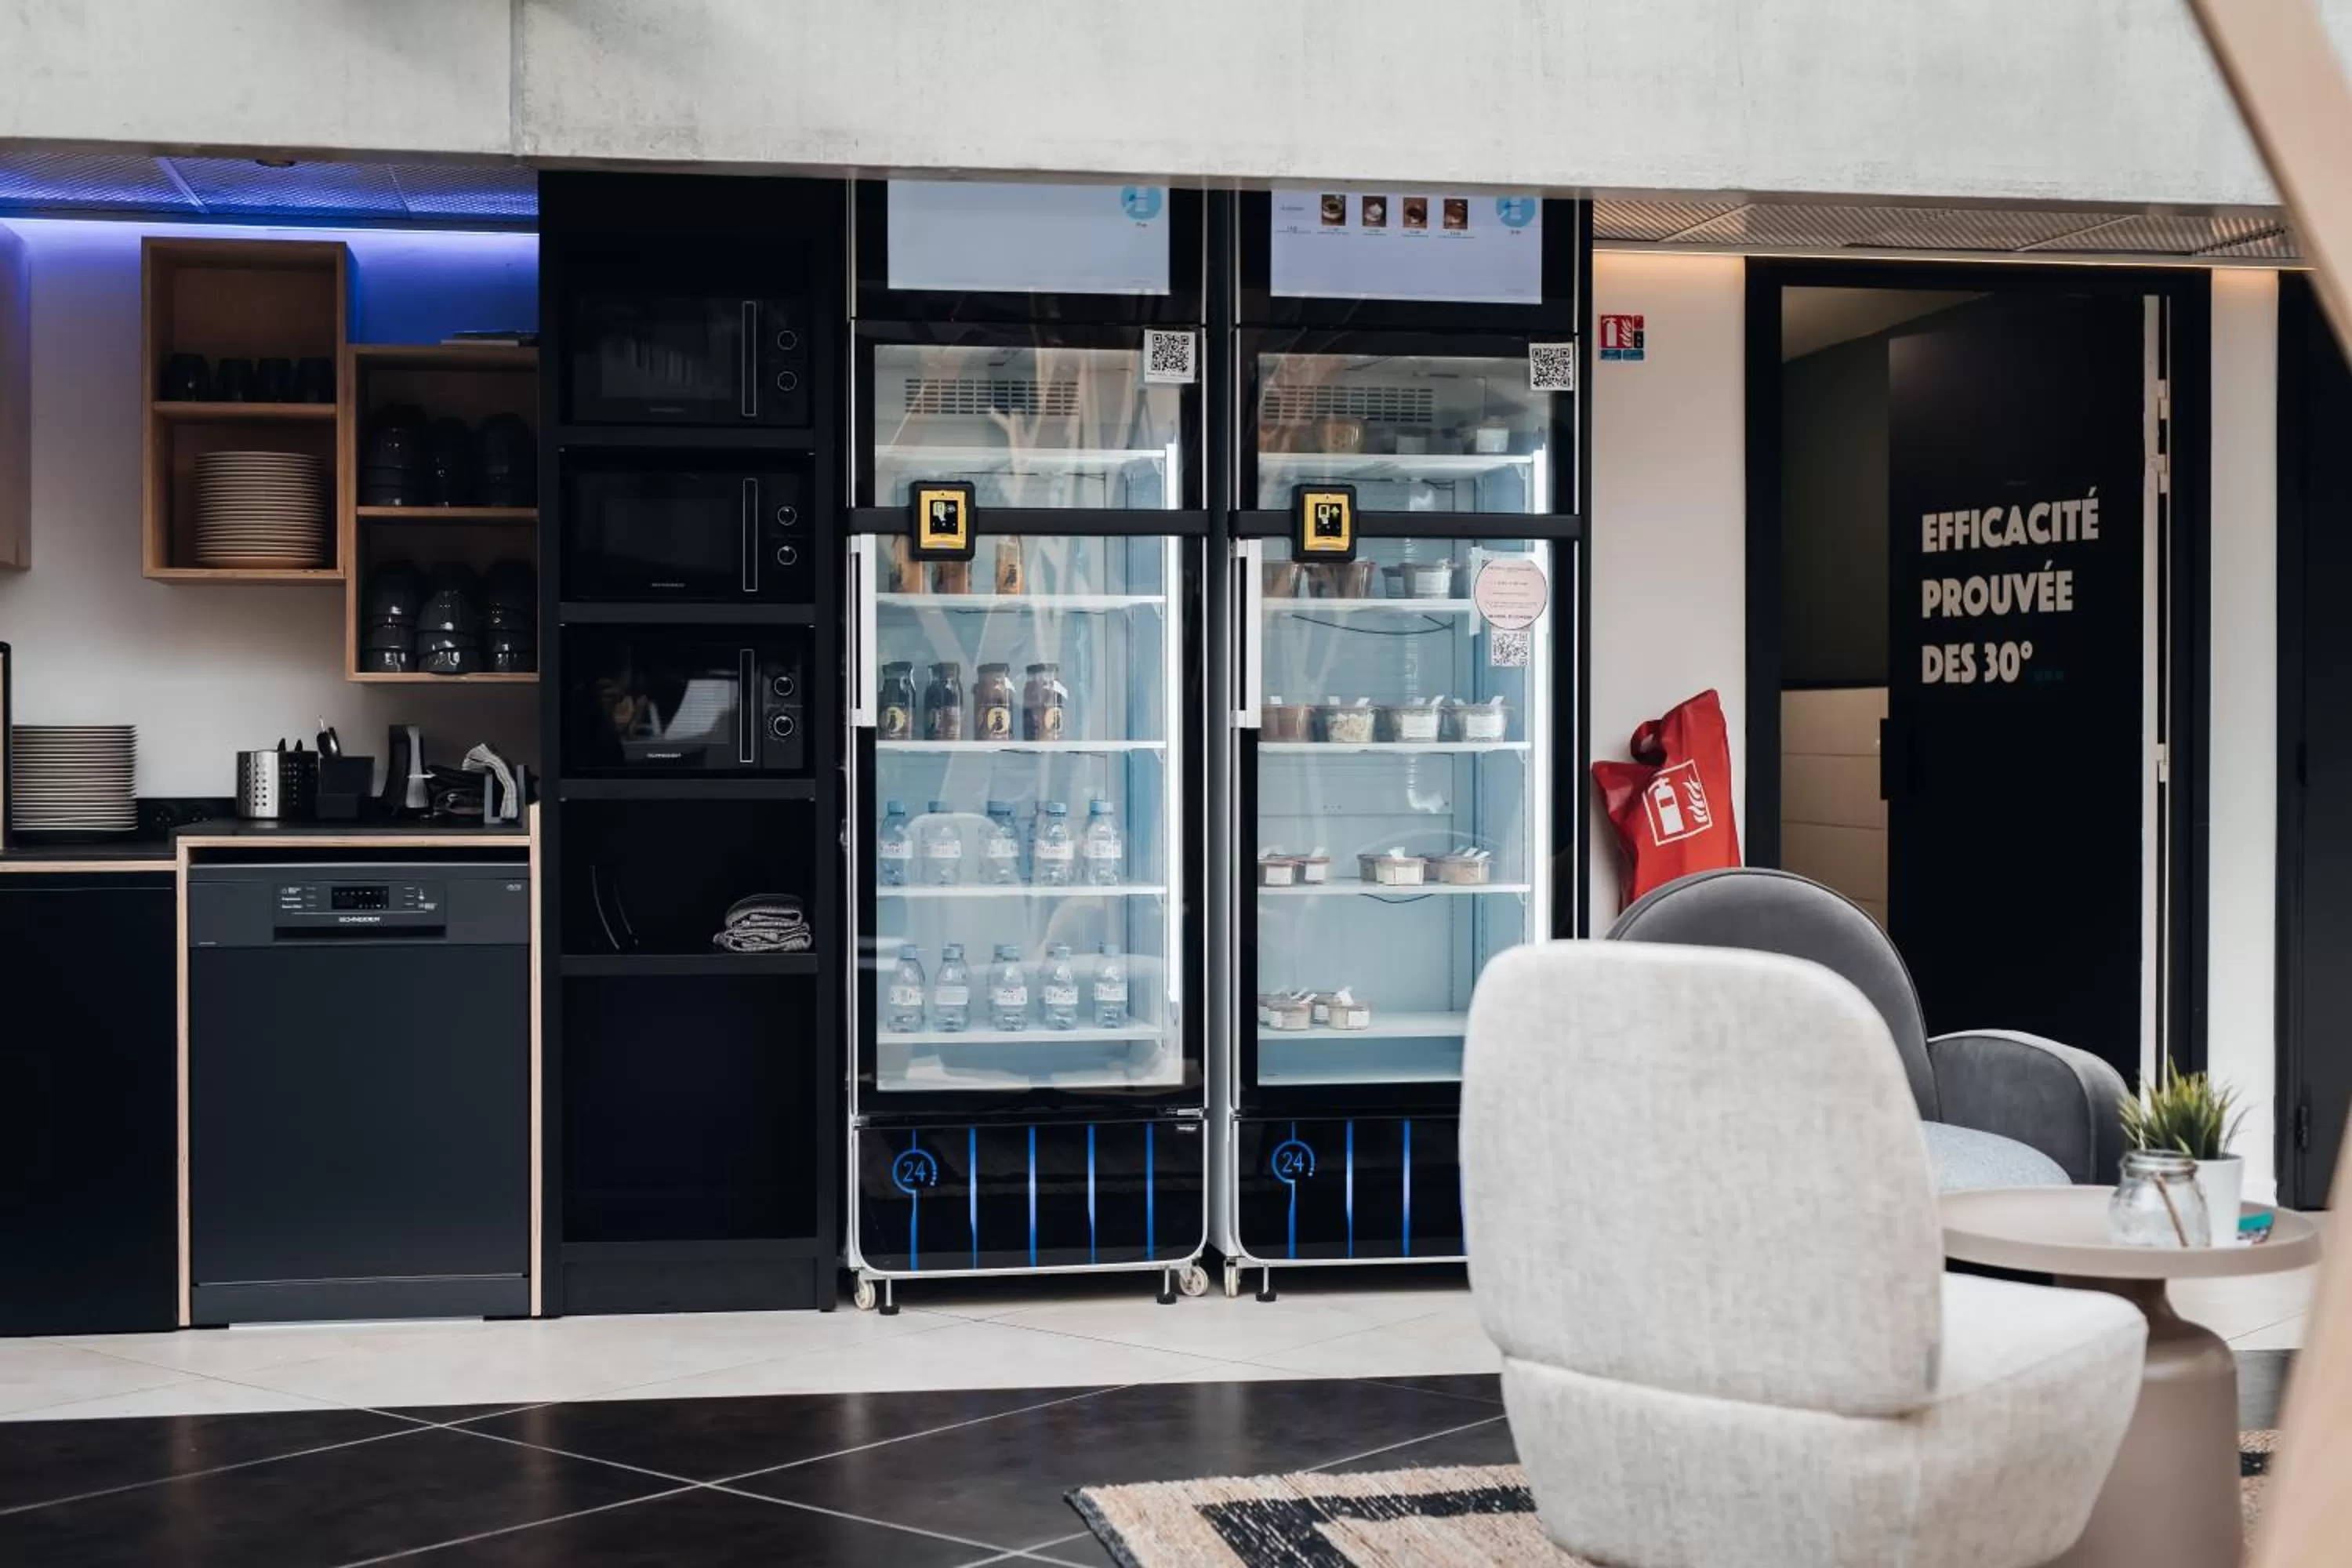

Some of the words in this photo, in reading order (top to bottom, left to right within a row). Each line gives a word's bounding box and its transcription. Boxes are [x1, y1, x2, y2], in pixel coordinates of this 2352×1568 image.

[1922, 486, 2100, 553] EFFICACITÉ
[1922, 560, 2074, 619] PROUVÉE
[1922, 642, 1977, 684] DES
[1984, 641, 2034, 683] 30°
[902, 1160, 927, 1182] 24
[1282, 1151, 1305, 1173] 24
